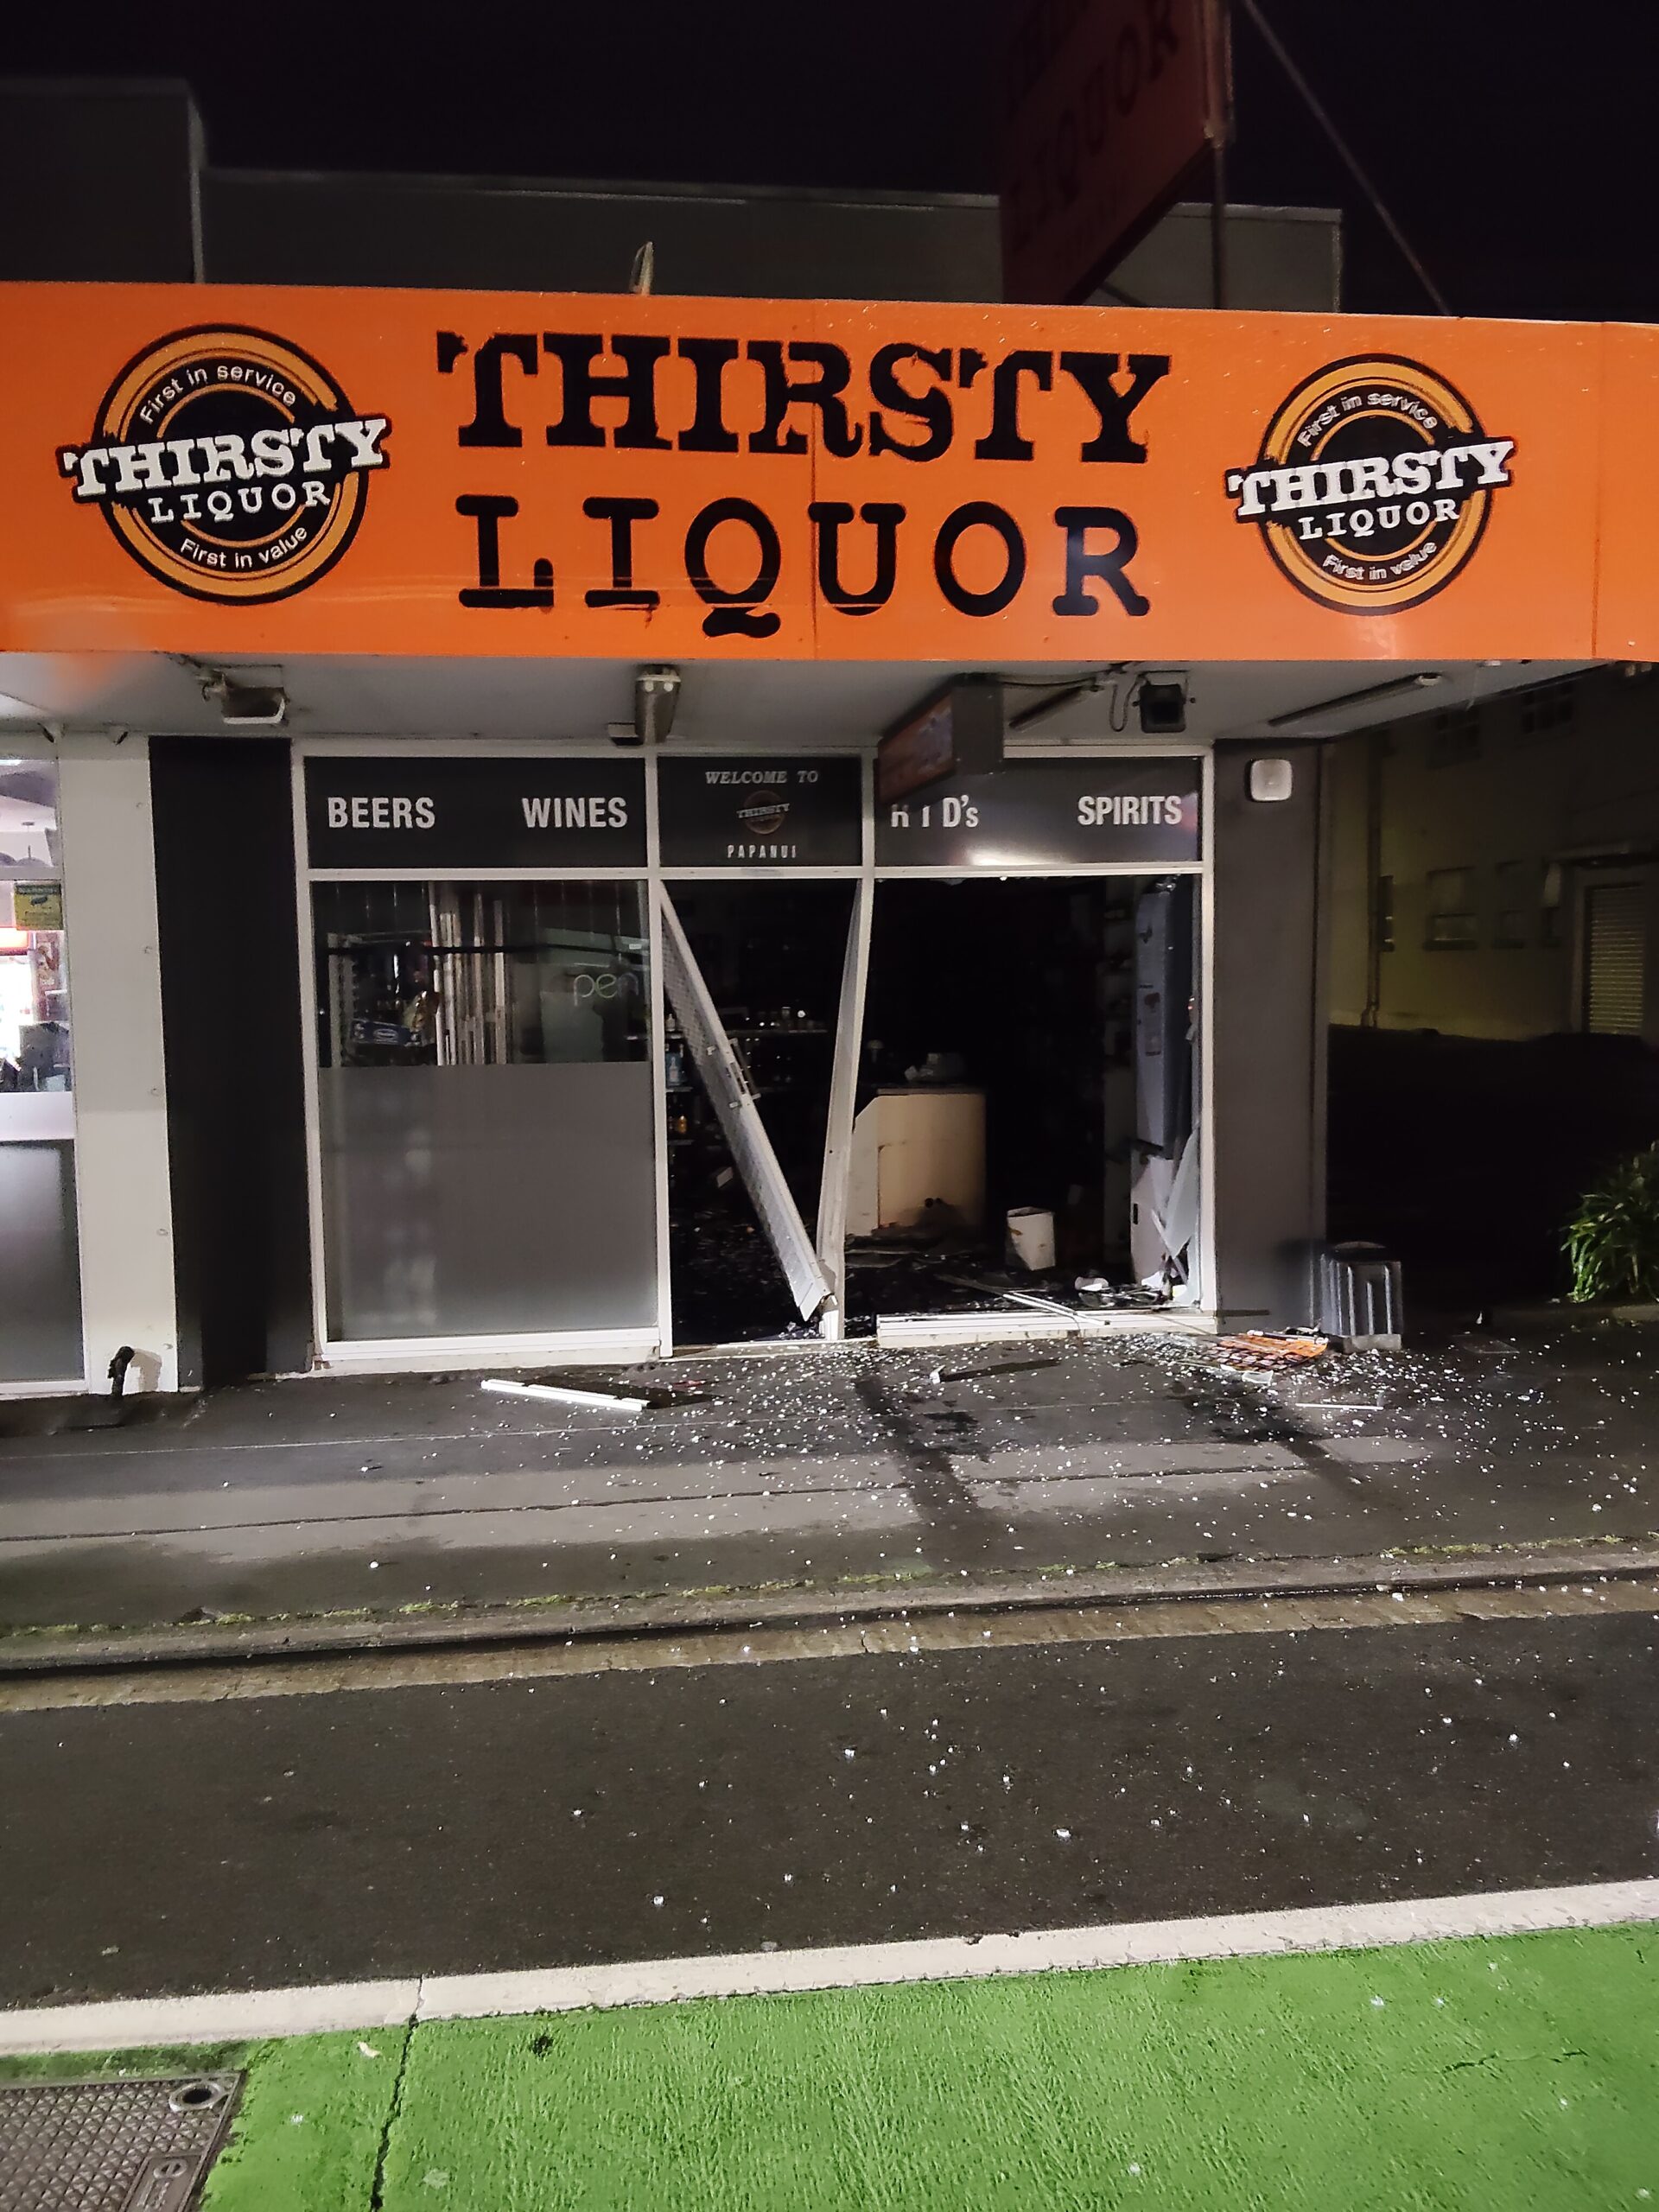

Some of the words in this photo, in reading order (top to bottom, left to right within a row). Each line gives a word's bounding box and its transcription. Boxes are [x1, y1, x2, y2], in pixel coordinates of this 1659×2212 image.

[139, 377, 184, 424] First
[188, 367, 208, 386] in
[216, 365, 297, 406] service
[437, 331, 1173, 465] THIRSTY
[1297, 404, 1340, 448] First
[1342, 392, 1363, 412] in
[1367, 391, 1438, 429] service
[63, 418, 387, 497] THIRSTY
[1228, 441, 1514, 517] THIRSTY
[148, 480, 331, 524] LIQUOR
[1299, 499, 1459, 541] LIQUOR
[180, 538, 226, 568] First
[234, 551, 252, 569] in
[258, 524, 308, 565] value
[455, 493, 1152, 639] LIQUOR
[1323, 554, 1364, 581] First
[1369, 564, 1387, 581] in
[1390, 540, 1437, 574] value
[705, 770, 788, 785] WELCOME
[797, 770, 819, 784] TO
[327, 797, 435, 829] BEERS
[522, 797, 628, 829] WINES
[1077, 795, 1182, 826] SPIRITS
[727, 844, 797, 858] PAPANUI
